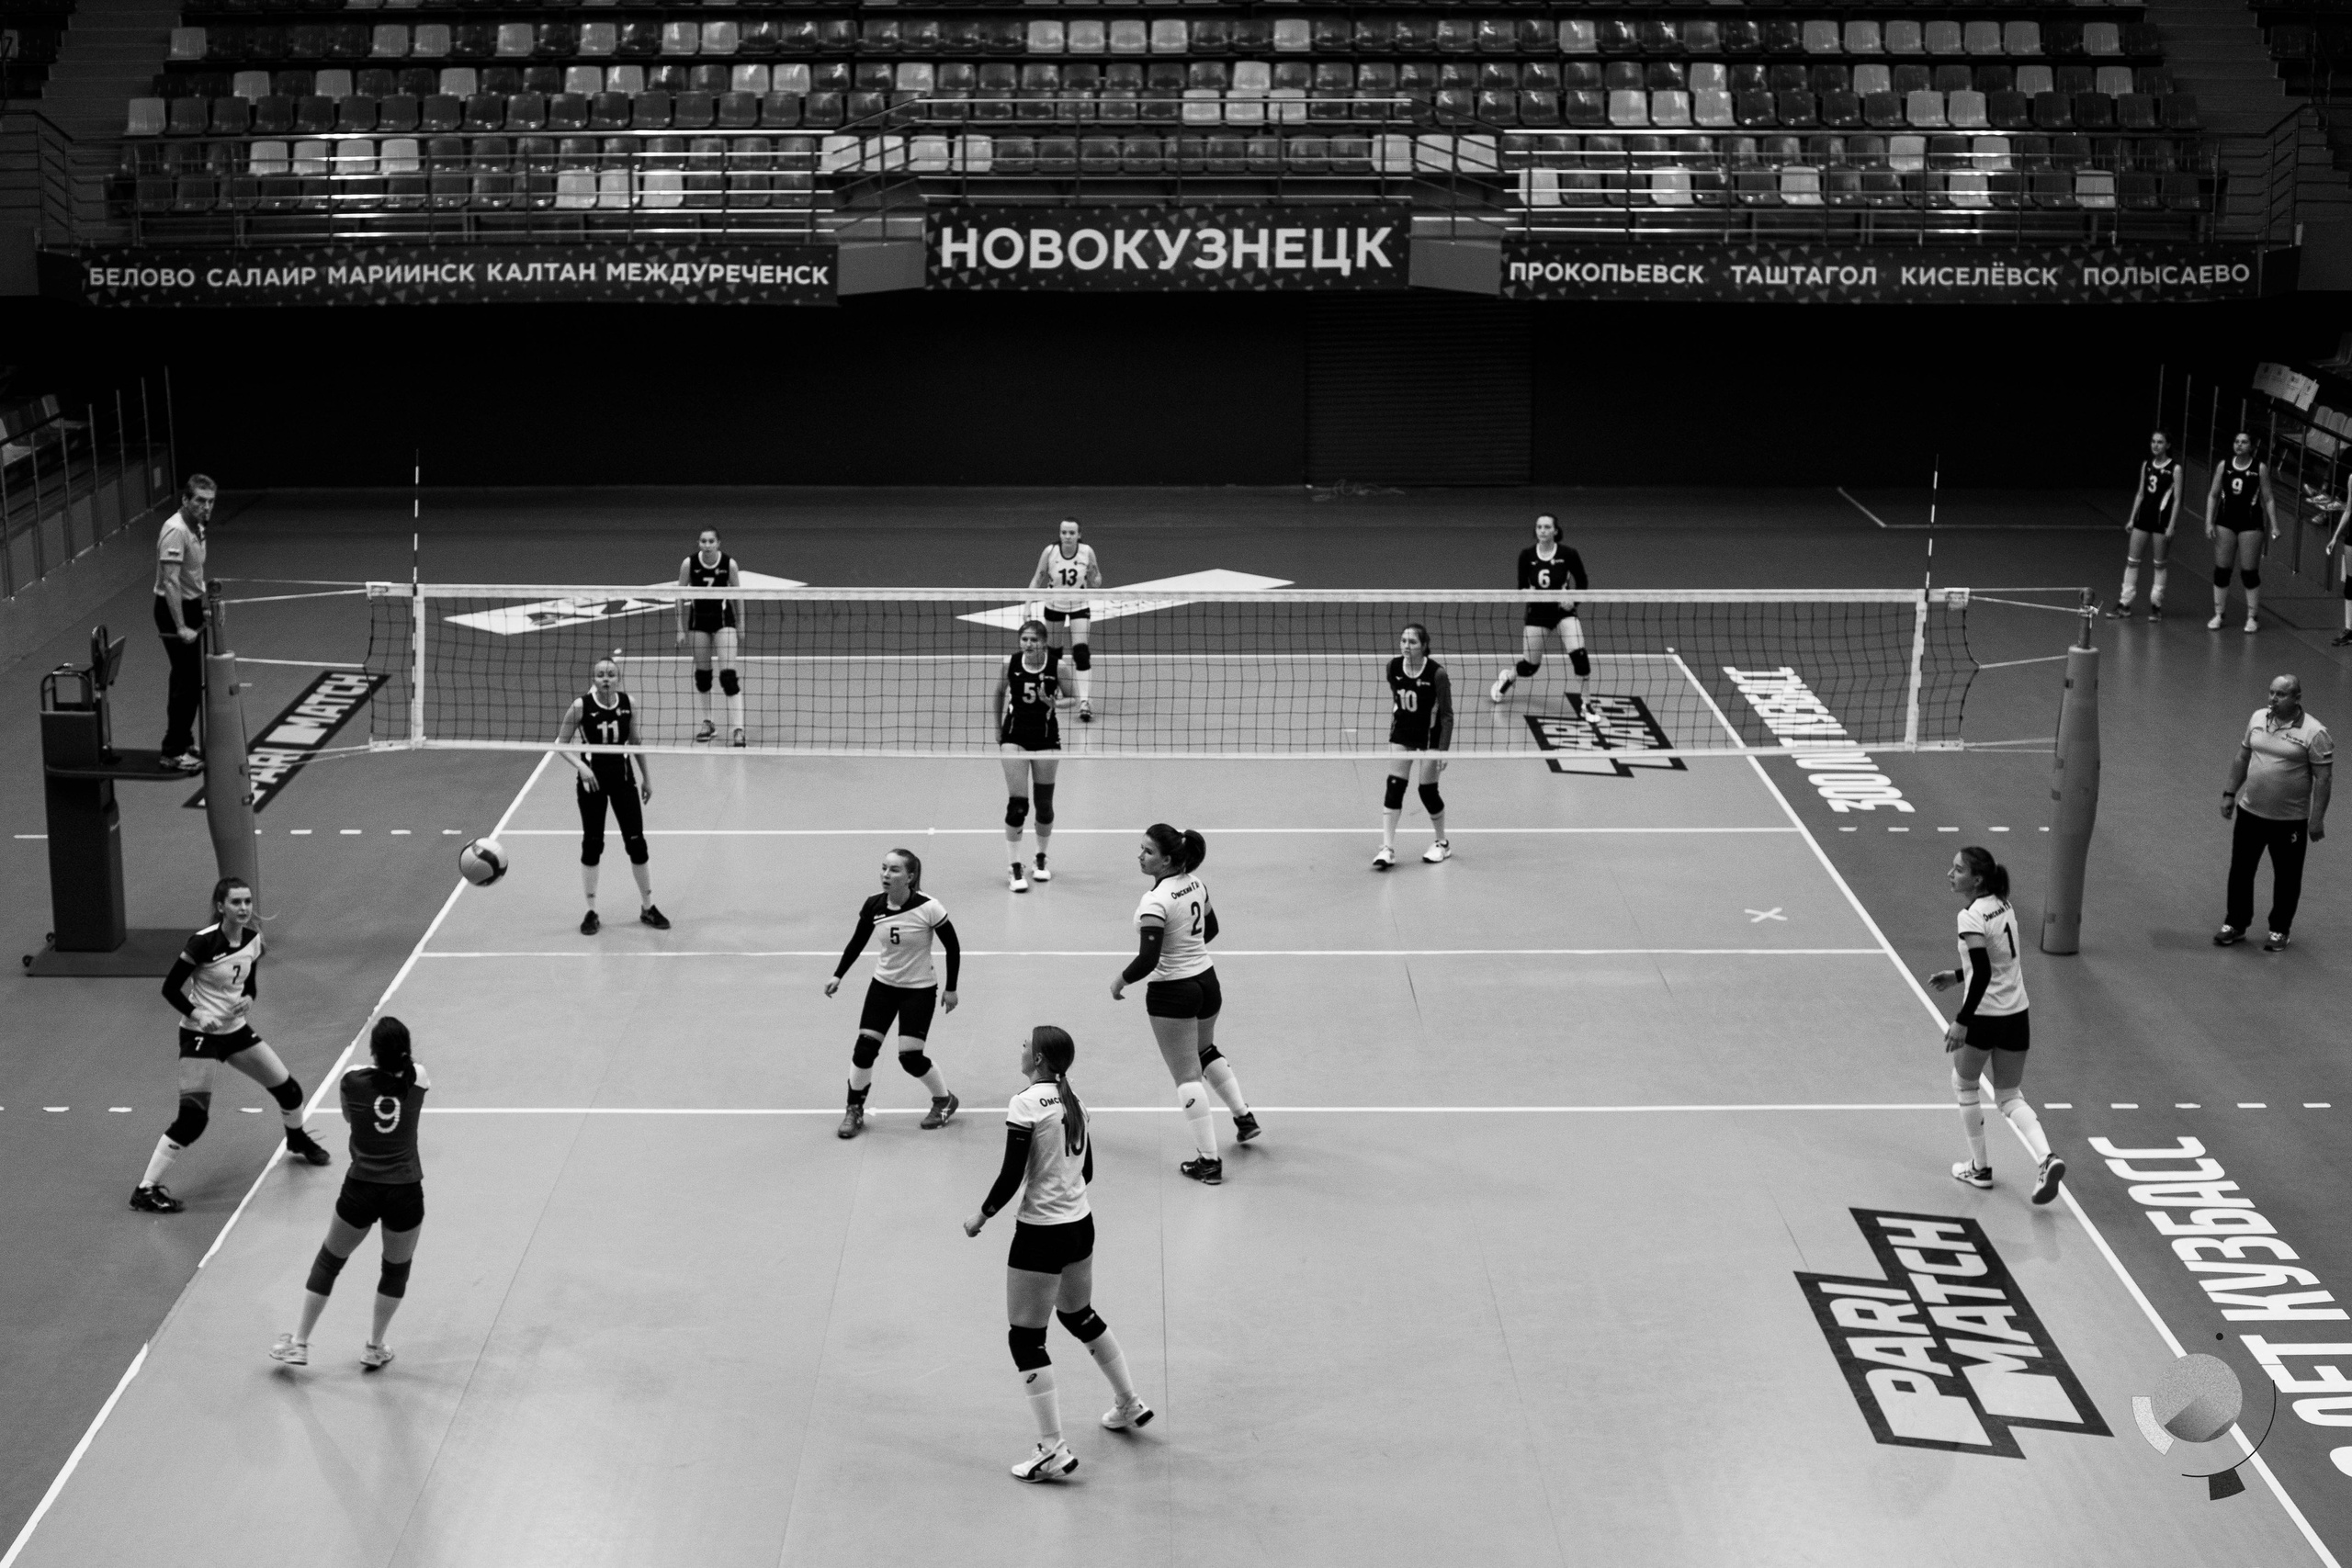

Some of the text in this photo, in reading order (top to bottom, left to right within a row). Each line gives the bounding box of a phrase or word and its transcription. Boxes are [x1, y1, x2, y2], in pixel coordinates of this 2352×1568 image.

[941, 227, 1393, 276] НОВОКУЗНЕЦК
[90, 262, 829, 287] БЕЛОВО САЛАИР МАРИИНСК КАЛТАН МЕЖДУРЕЧЕНСК
[1510, 261, 2250, 286] ПРОКОПЬЕВСК ТАШТАГОЛ КИСЕЛЁВСК ПОЛЫСАЕВО
[2147, 474, 2158, 493] 3
[2232, 478, 2243, 495] 9
[1058, 568, 1078, 586] 13
[1538, 569, 1551, 588] 6
[1022, 682, 1036, 705] 5
[1396, 688, 1418, 712] 10
[1723, 667, 1848, 735] КУЗБАСС
[264, 673, 379, 745] MATCH
[596, 720, 619, 744] 11
[1807, 773, 1916, 813] 300
[1191, 901, 1203, 936] 2
[890, 927, 900, 945] 5
[2004, 921, 2017, 959] 1
[232, 964, 242, 985] 7
[194, 1036, 204, 1051] 7
[374, 1095, 401, 1134] 9
[2087, 1136, 2351, 1321] КУЗБАСС
[1876, 1216, 2085, 1424] MATCH
[1817, 1281, 1994, 1447] PARI
